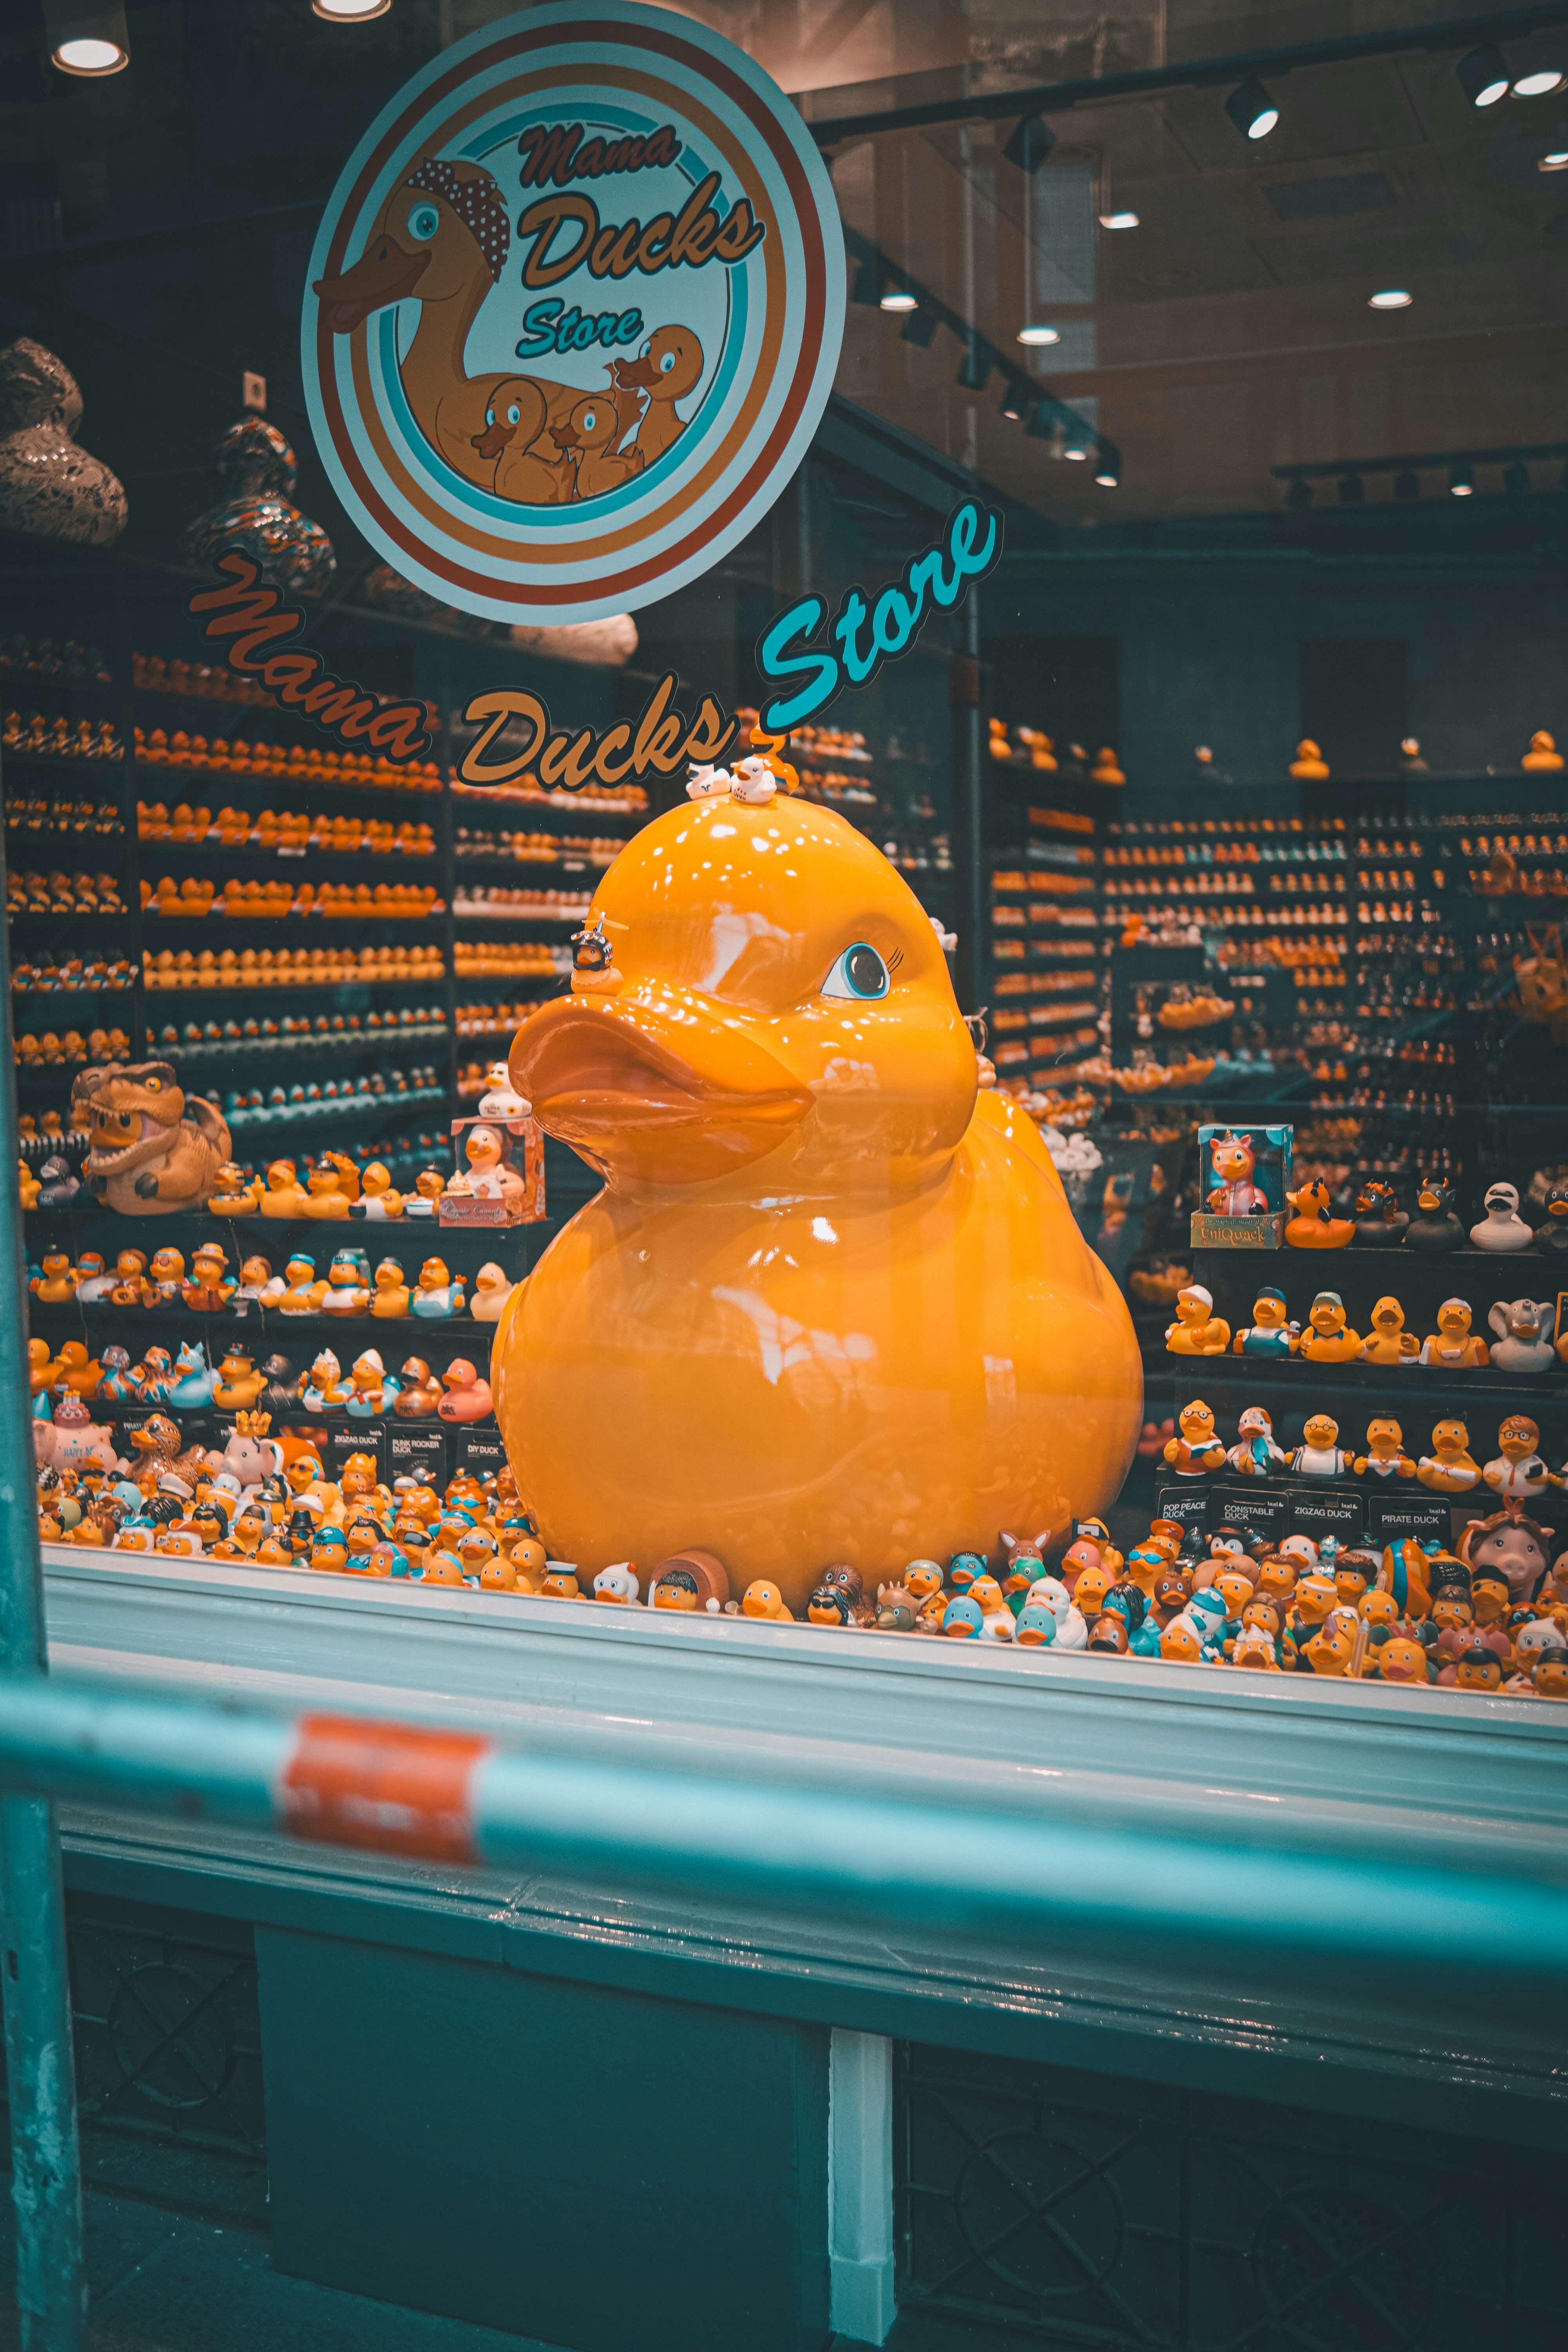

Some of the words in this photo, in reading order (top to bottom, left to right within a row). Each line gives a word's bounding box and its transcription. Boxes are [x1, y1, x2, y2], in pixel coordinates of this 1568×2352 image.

[517, 122, 682, 189] Mama
[517, 171, 765, 290] Ducks
[515, 297, 644, 358] Store
[185, 548, 430, 764] Mama
[458, 671, 739, 791] Ducks
[756, 498, 1004, 734] Store
[359, 1436, 378, 1445] DUCK
[411, 1439, 439, 1448] ROCKER
[468, 1445, 479, 1453] DIY
[479, 1446, 499, 1455] DUCK
[1181, 1501, 1206, 1510] PEACE
[1224, 1504, 1274, 1516] CONSTABLE
[1163, 1510, 1185, 1519] DUCK
[1225, 1512, 1249, 1520] DUCK
[1294, 1506, 1325, 1516] ZIGZAG
[1327, 1509, 1352, 1519] DUCK
[1381, 1515, 1412, 1523] PIRATE
[1413, 1516, 1439, 1524] DUCK
